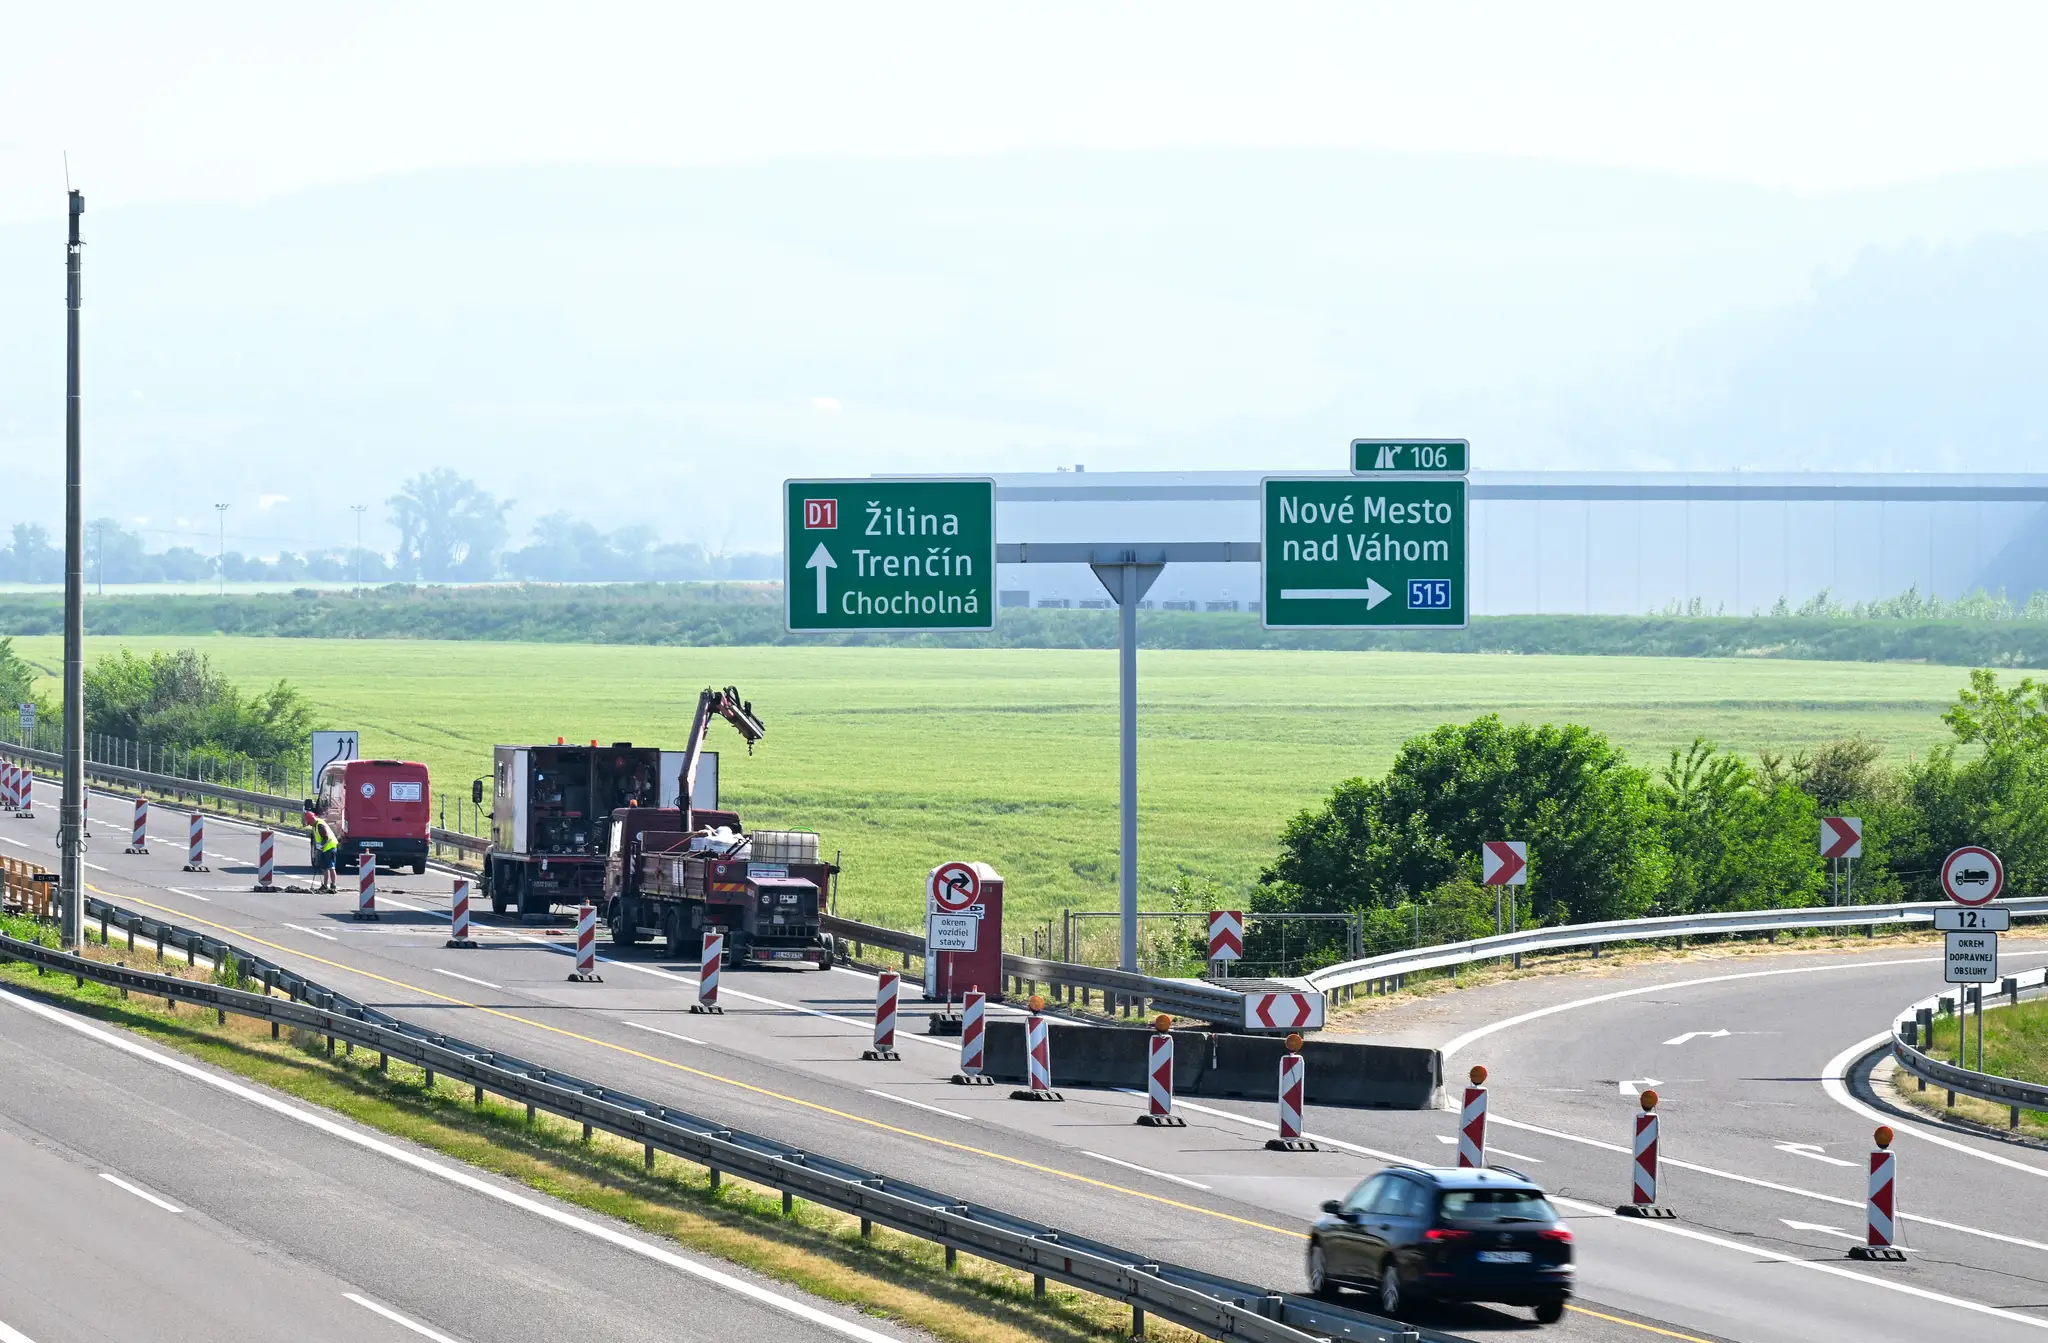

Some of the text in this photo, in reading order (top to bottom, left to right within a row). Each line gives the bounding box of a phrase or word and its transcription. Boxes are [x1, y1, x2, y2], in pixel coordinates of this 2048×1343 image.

[1410, 446, 1448, 468] 106
[809, 502, 832, 525] D1
[865, 500, 959, 536] Žilina
[1279, 494, 1452, 524] Nové Mesto
[1283, 532, 1449, 562] nad Váhom
[851, 546, 973, 578] Trenčín
[842, 588, 979, 616] Chocholná
[1412, 583, 1446, 606] 515
[941, 919, 967, 927] okrem
[1958, 911, 1986, 928] 12 t
[938, 928, 969, 937] vozidiel
[939, 938, 966, 947] stavby
[1958, 940, 1985, 948] OKREM
[1949, 953, 1993, 962] DOPRAVNEJ
[1954, 966, 1988, 976] OBSLUHY
